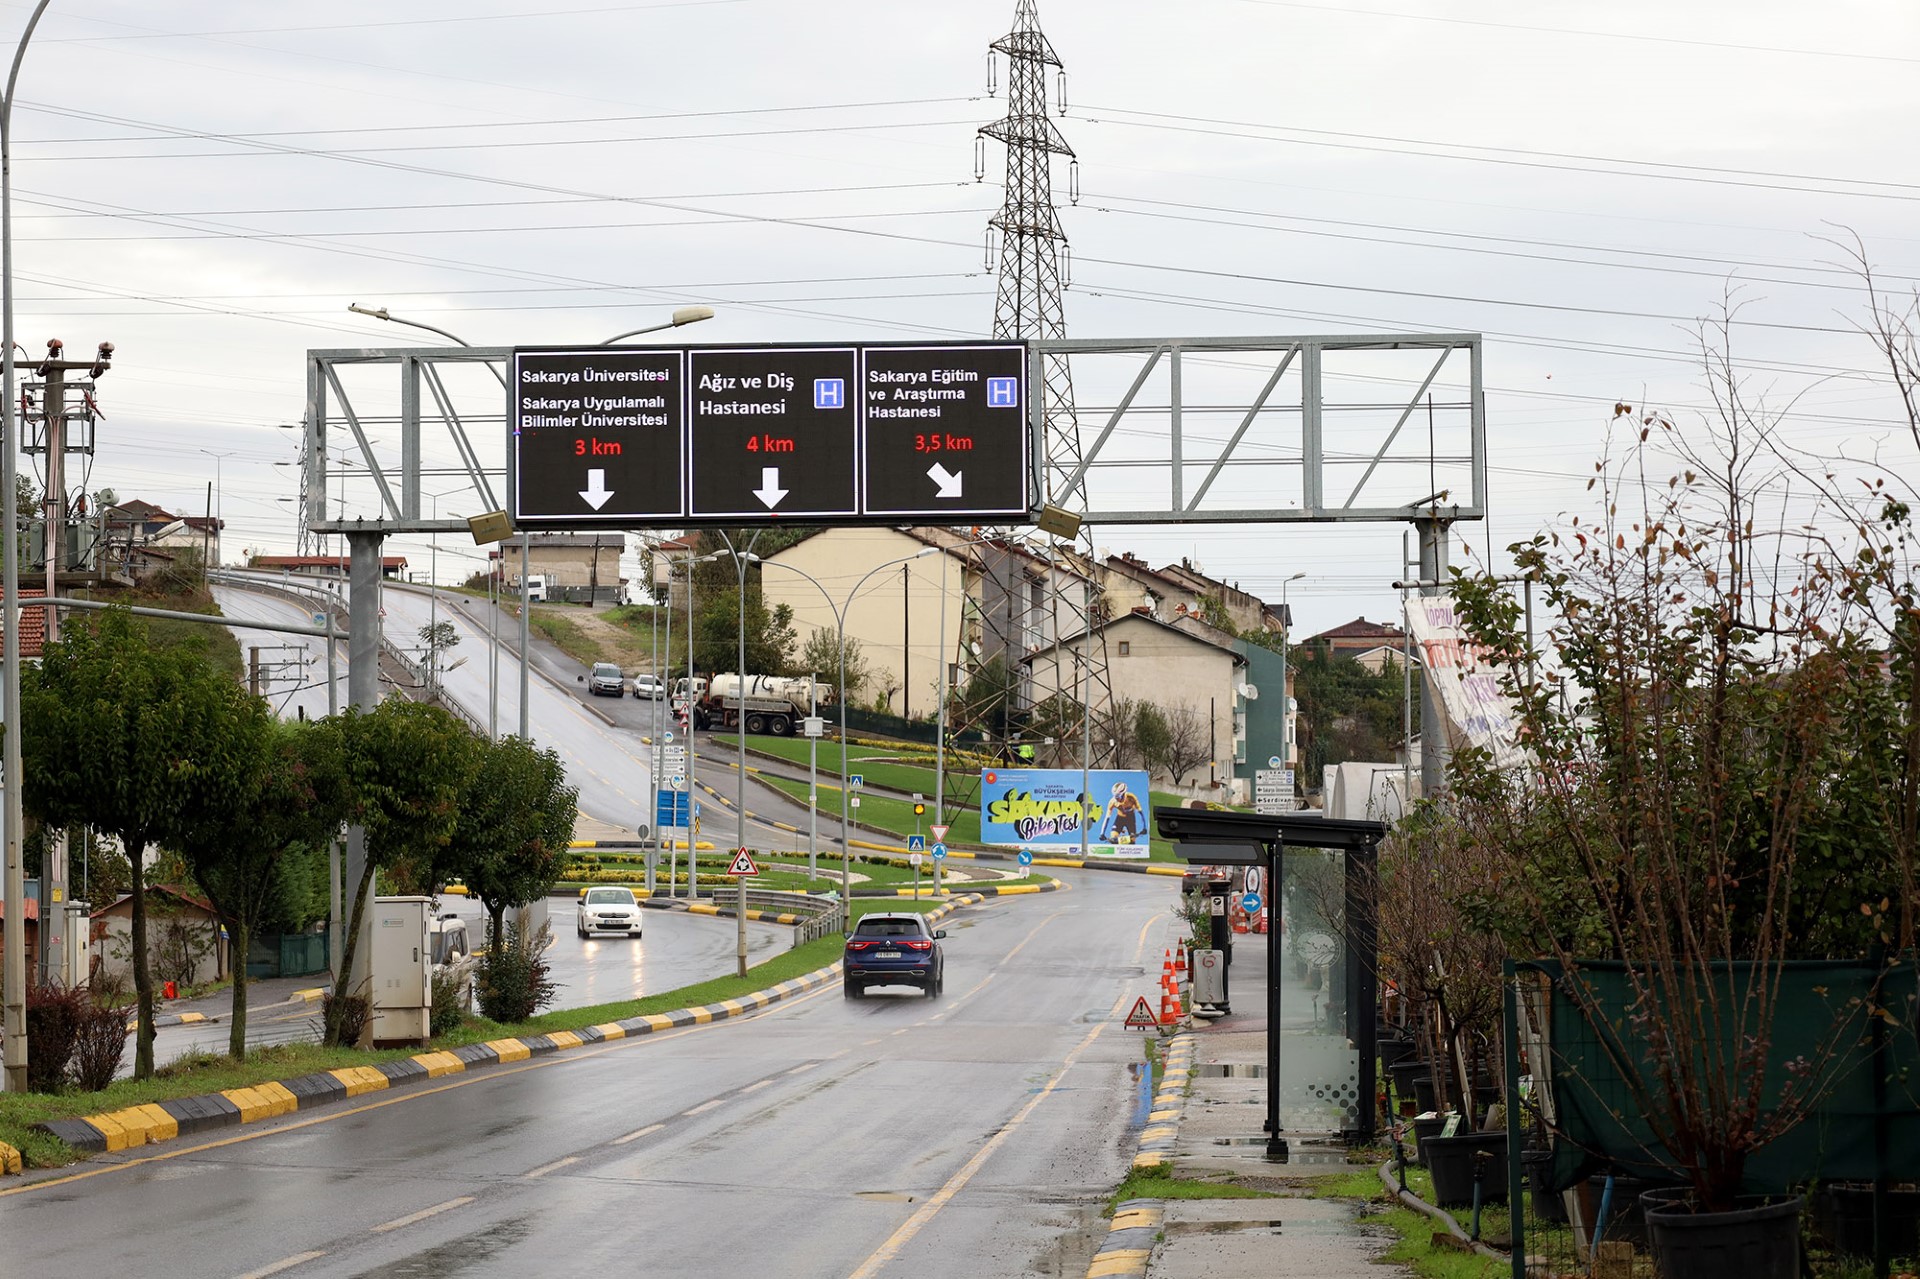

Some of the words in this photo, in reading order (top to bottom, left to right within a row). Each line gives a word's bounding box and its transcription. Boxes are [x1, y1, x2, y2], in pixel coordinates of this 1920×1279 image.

[522, 370, 579, 384] Sakarya
[583, 367, 669, 382] Üniversitesi
[699, 374, 736, 392] Ağız
[741, 377, 762, 389] ve
[767, 373, 795, 391] Diş
[869, 370, 927, 385] Sakarya
[931, 369, 978, 384] Eğitim
[522, 397, 580, 411] Sakarya
[584, 395, 665, 411] Uygulamalı
[868, 390, 886, 401] ve
[893, 388, 966, 402] Araştırma
[700, 398, 786, 415] Hastanesi
[868, 405, 941, 418] Hastanesi
[521, 414, 579, 427] Bilimler
[582, 411, 668, 427] Üniversitesi
[575, 438, 587, 456] 3
[592, 437, 622, 455] km
[746, 436, 759, 453] 4
[764, 434, 795, 453] km
[915, 434, 941, 454] 3,5
[945, 433, 973, 450] km
